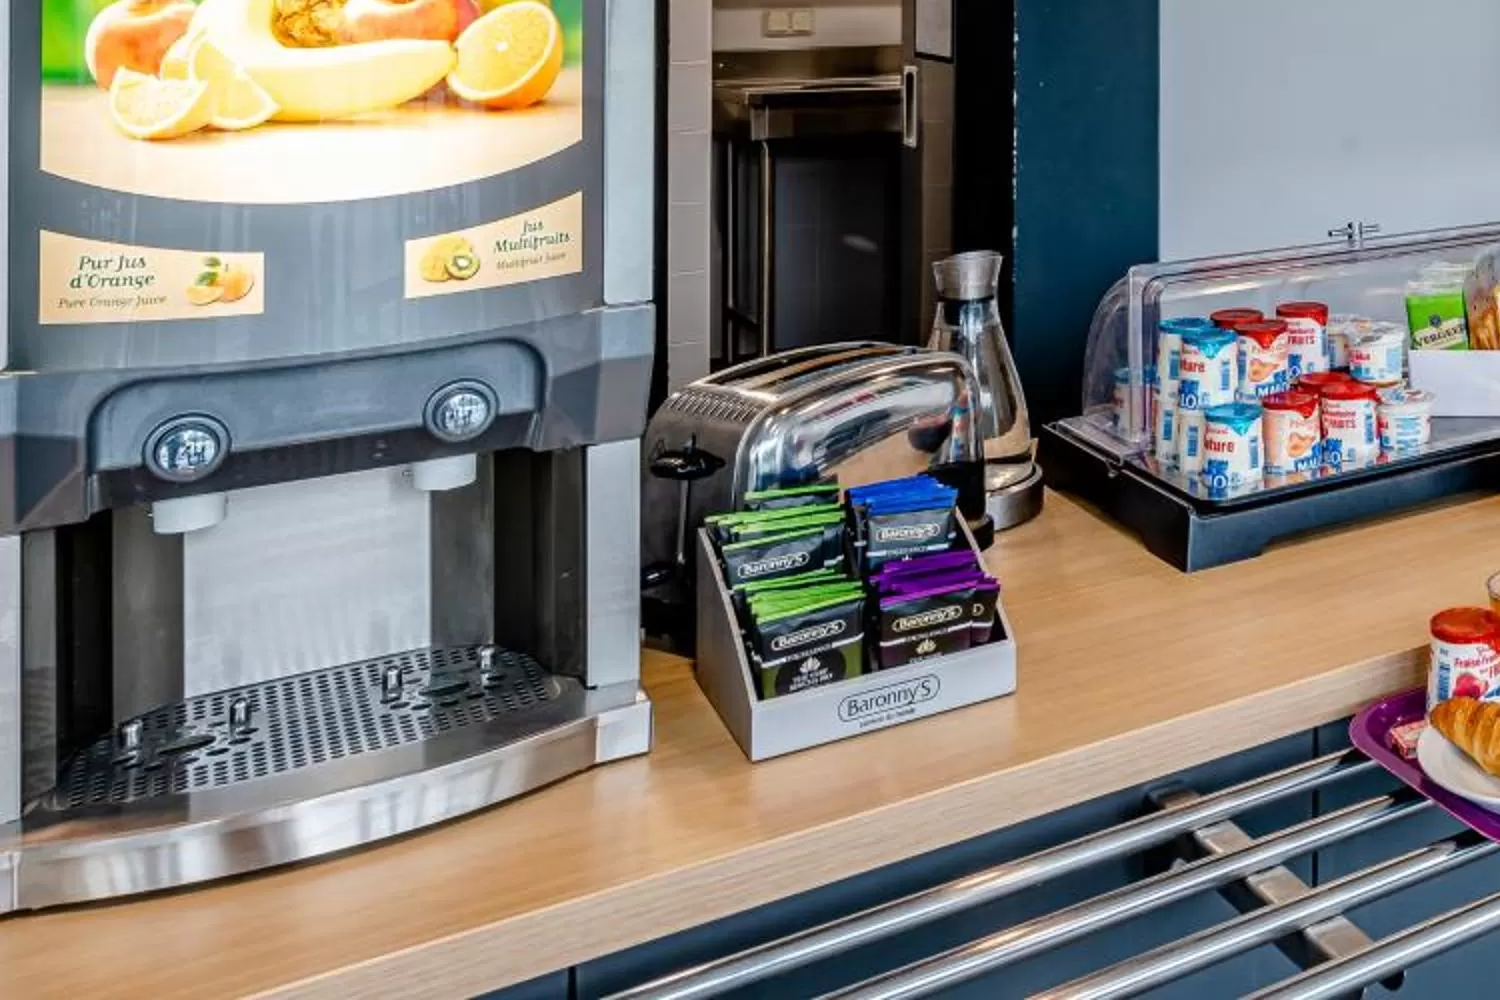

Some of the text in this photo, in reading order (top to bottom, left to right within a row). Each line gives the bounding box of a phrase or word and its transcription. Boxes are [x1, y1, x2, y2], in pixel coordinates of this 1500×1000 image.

[78, 254, 147, 272] Pur Jus
[68, 272, 156, 291] d'Orange
